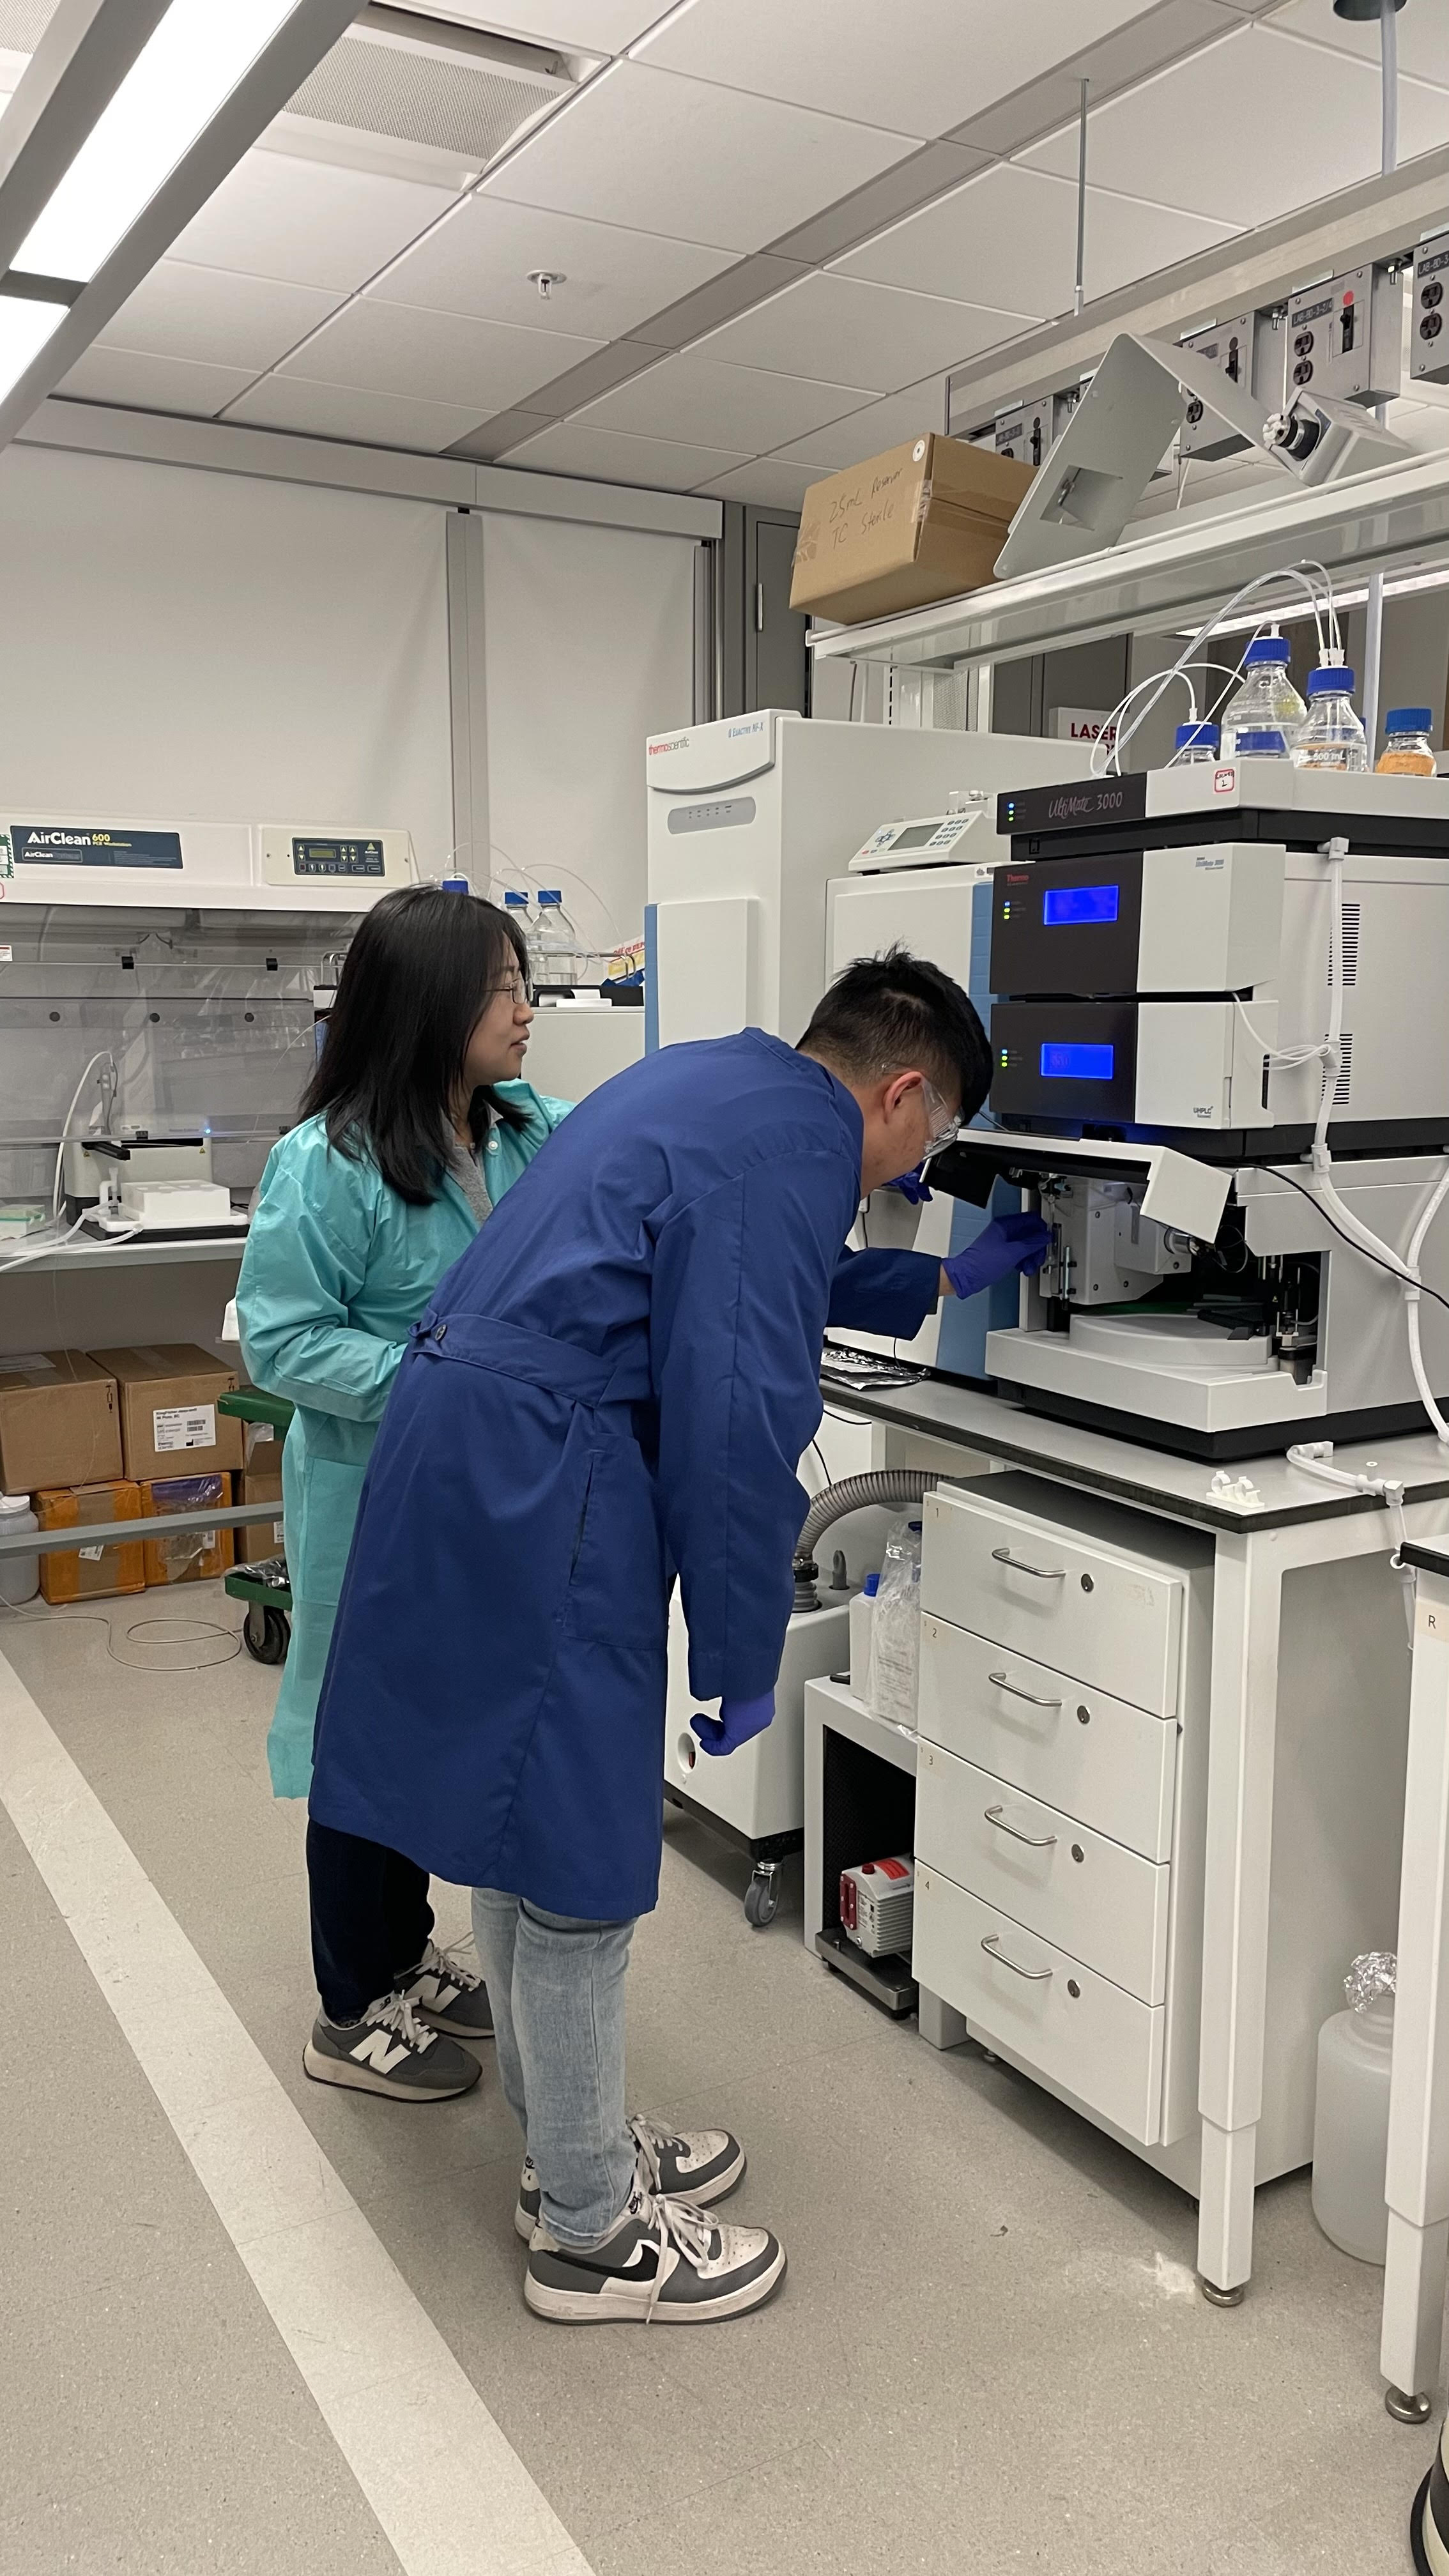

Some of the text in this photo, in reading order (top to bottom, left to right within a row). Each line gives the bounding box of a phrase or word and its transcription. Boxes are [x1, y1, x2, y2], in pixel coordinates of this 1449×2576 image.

[832, 523, 848, 550] TC
[1071, 723, 1117, 740] LASER
[1096, 792, 1123, 811] 3000
[27, 832, 111, 845] AirClean 600
[936, 1507, 939, 1519] 1
[1428, 1615, 1436, 1629] R
[932, 1627, 937, 1639] 2
[929, 1755, 933, 1766] 3
[924, 1880, 930, 1891] 4
